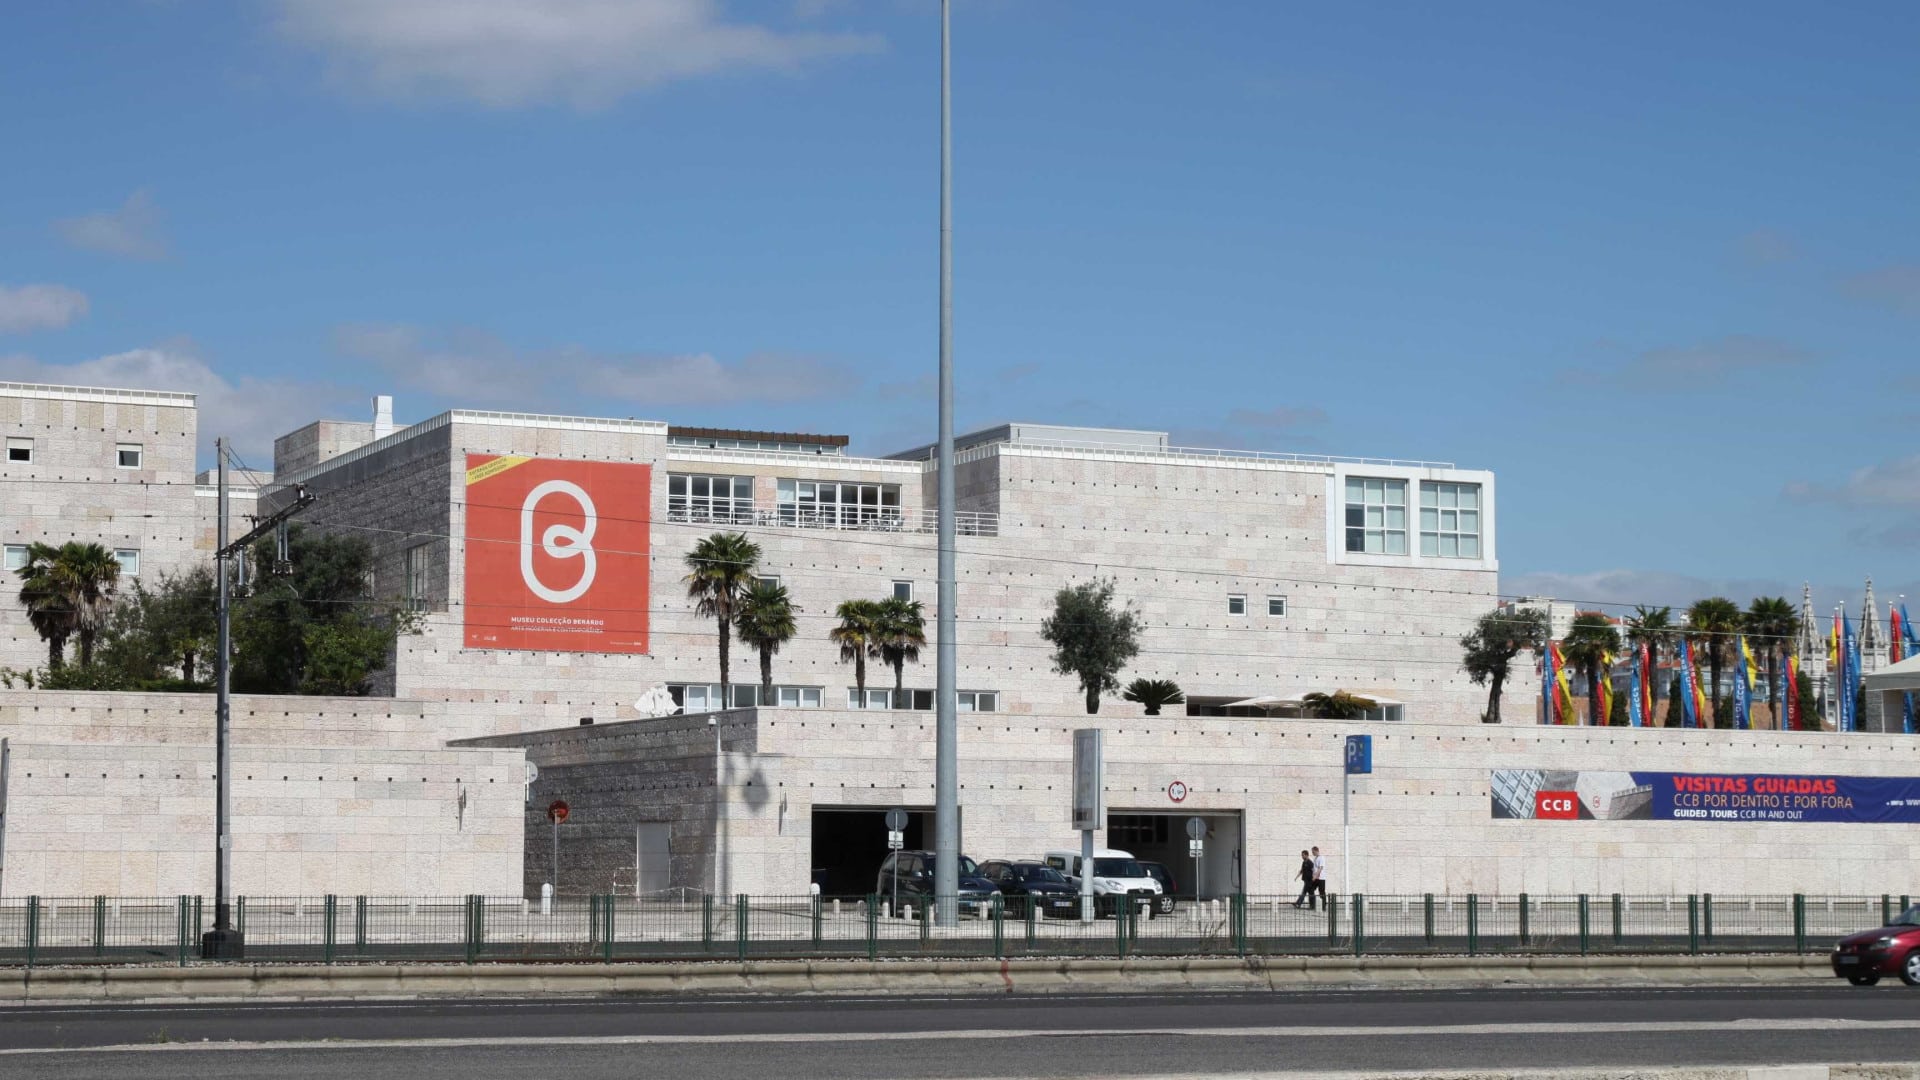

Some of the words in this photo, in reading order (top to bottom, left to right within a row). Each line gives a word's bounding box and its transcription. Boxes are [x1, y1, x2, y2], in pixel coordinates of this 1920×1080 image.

[511, 616, 535, 624] MUSEU
[536, 616, 571, 626] COLECÇÃO
[572, 618, 604, 626] BERARDO
[1348, 741, 1356, 764] P
[1673, 776, 1748, 793] VISITAS
[1753, 778, 1837, 794] GUIADAS
[1542, 799, 1572, 811] CCB
[1673, 793, 1700, 807] CCB
[1704, 794, 1727, 807] POR
[1731, 795, 1779, 808] DENTRO
[1784, 795, 1790, 808] E
[1794, 796, 1818, 809] POR
[1822, 796, 1853, 809] FORA
[1673, 809, 1707, 818] GUIDED
[1710, 809, 1738, 819] TOURS
[1740, 810, 1756, 819] CCB
[1758, 810, 1766, 819] IN
[1768, 810, 1785, 819] AND
[1787, 811, 1803, 820] OUT
